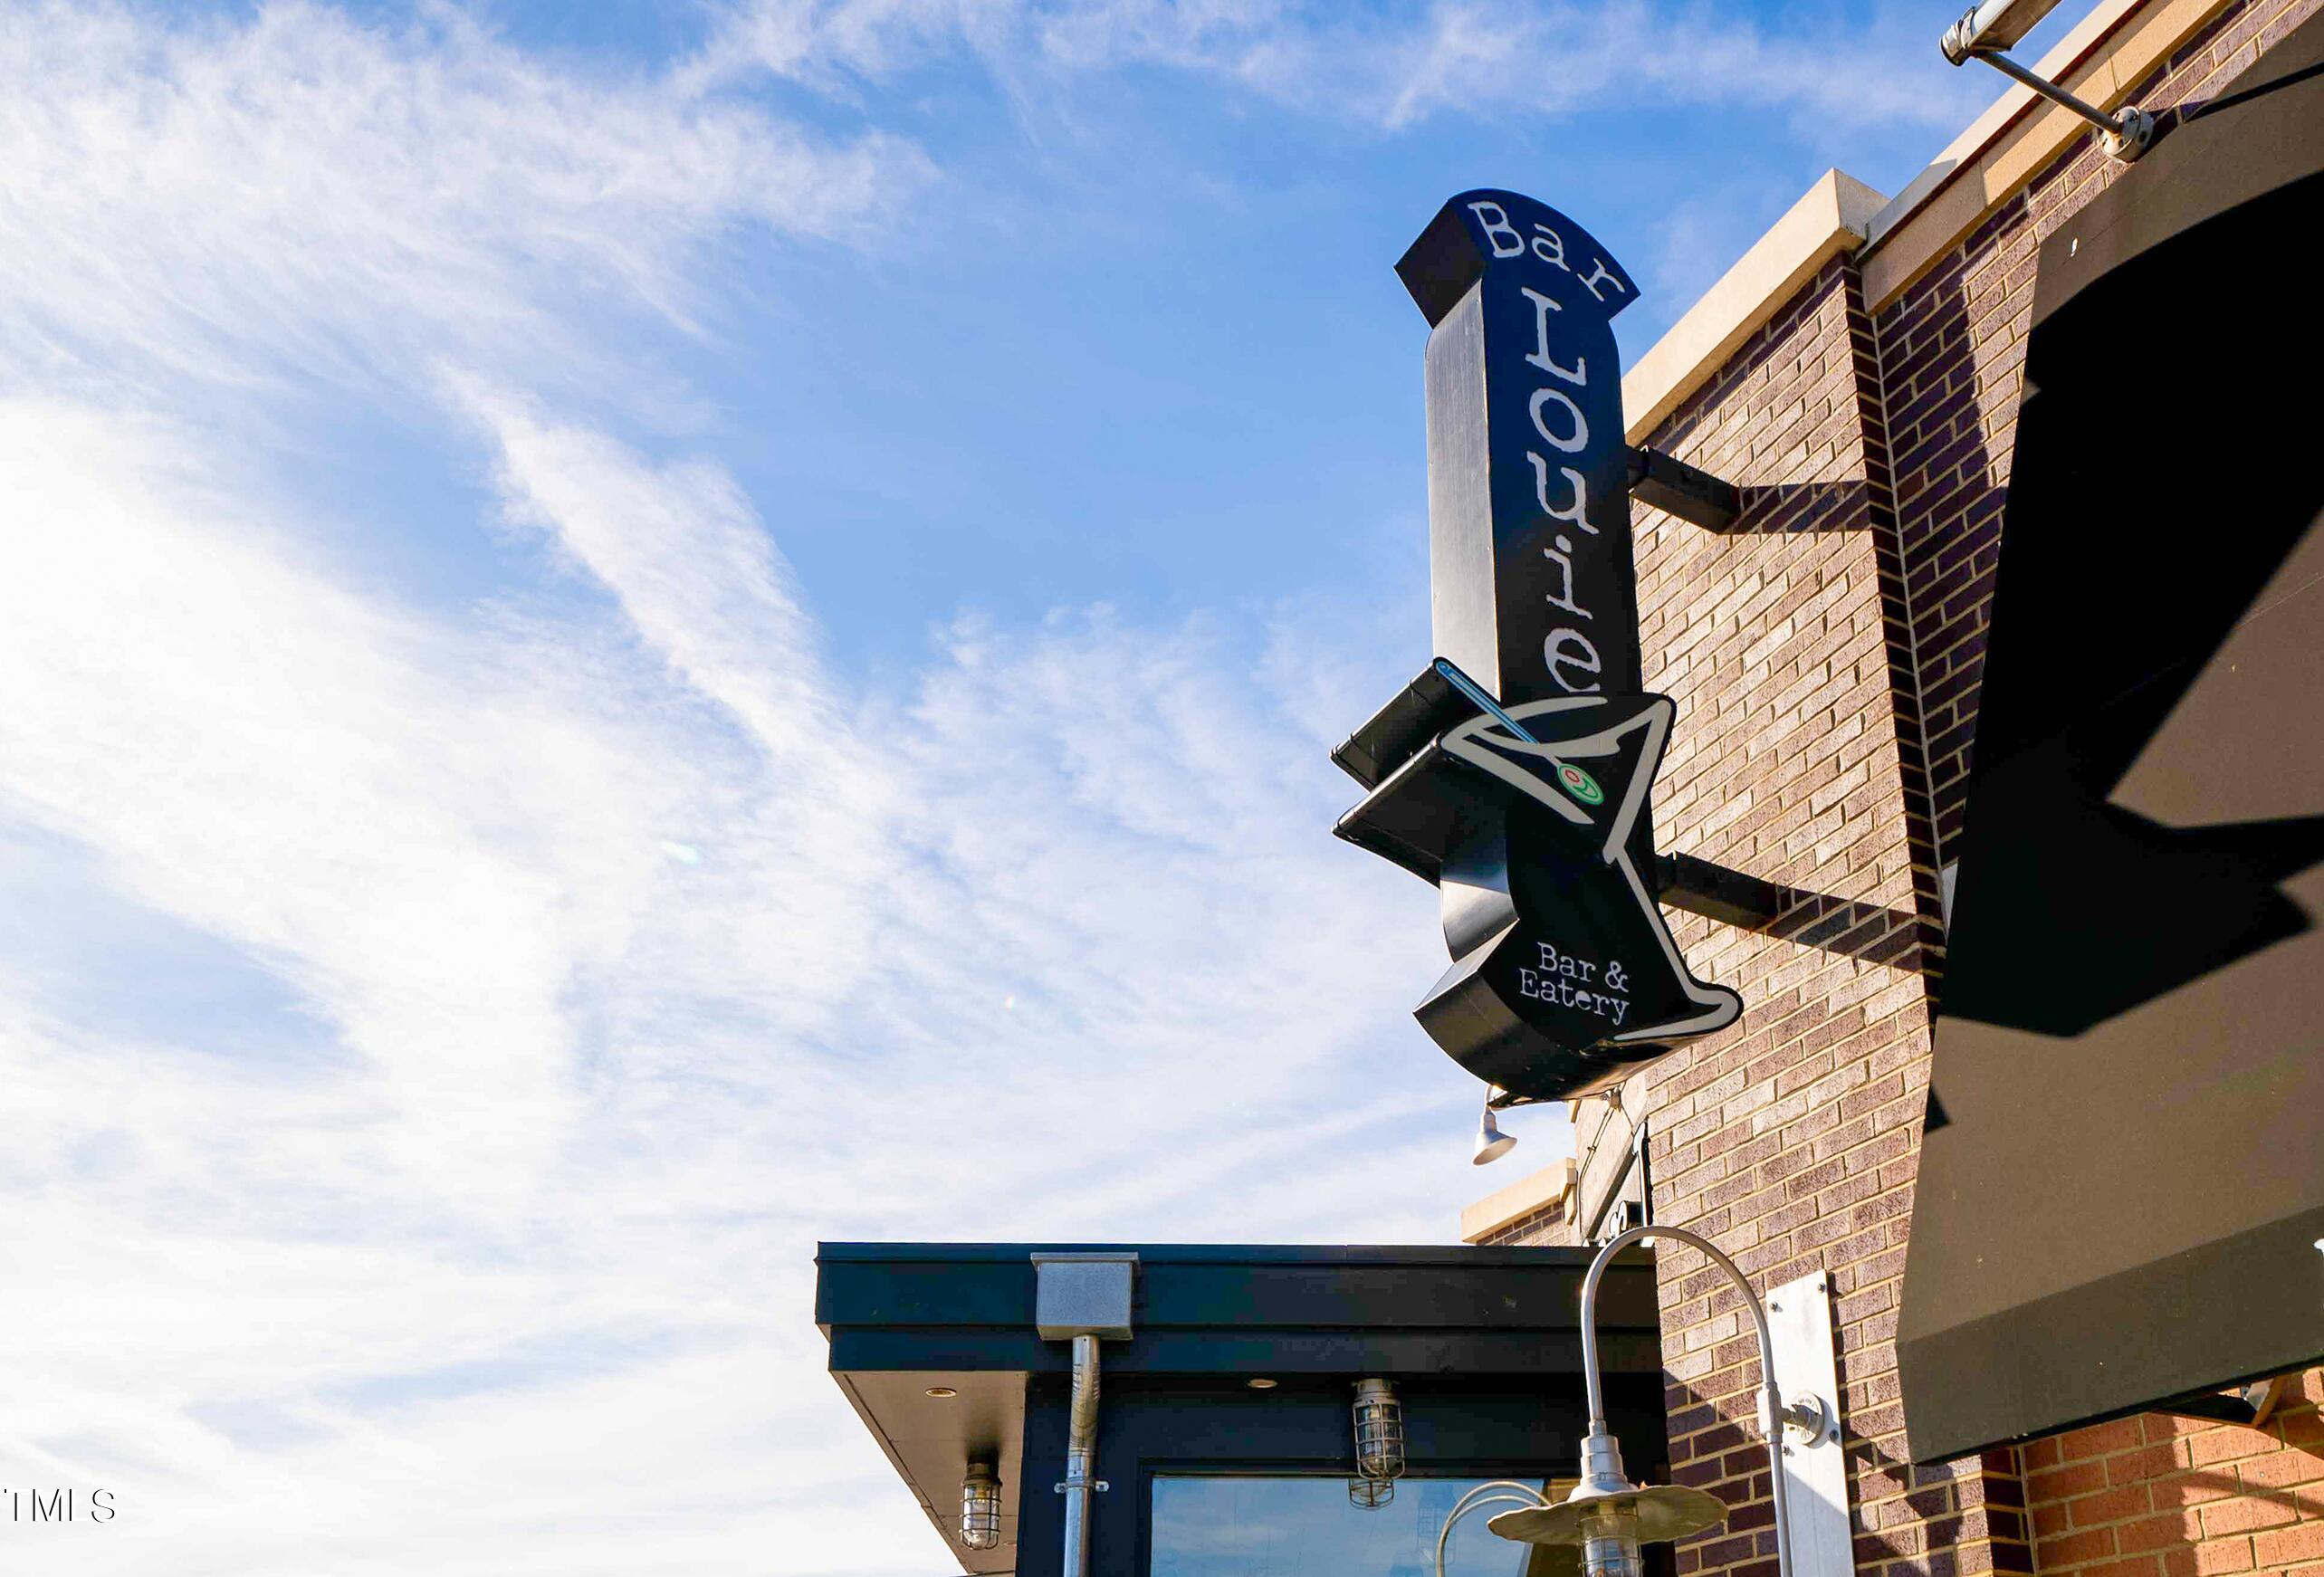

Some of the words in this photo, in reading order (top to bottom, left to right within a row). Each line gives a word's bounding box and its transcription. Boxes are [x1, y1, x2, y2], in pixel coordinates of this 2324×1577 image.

[1467, 200, 1625, 302] Bar
[1521, 287, 1602, 693] Louie
[1518, 968, 1630, 1026] Eatery
[1537, 941, 1596, 982] Bar
[1604, 961, 1630, 993] &
